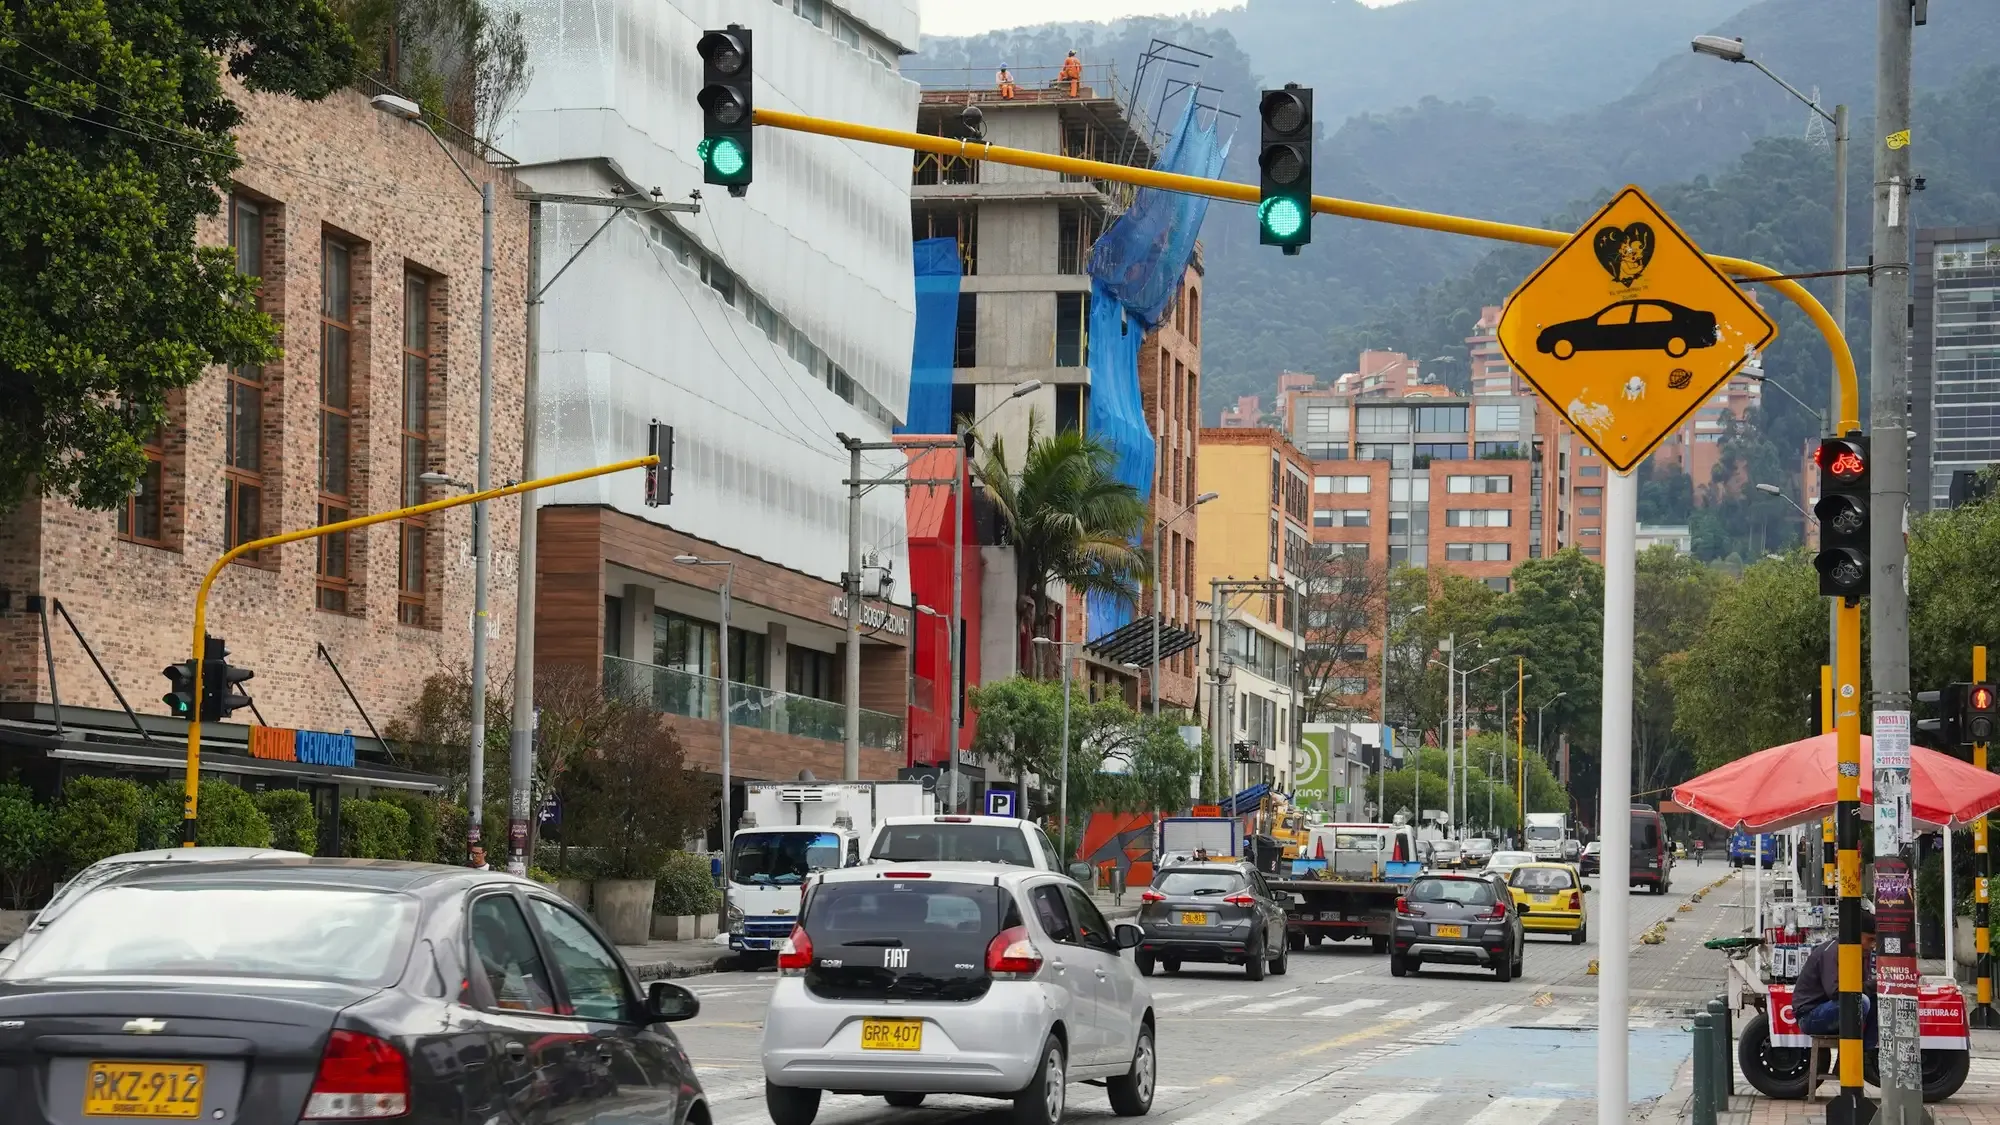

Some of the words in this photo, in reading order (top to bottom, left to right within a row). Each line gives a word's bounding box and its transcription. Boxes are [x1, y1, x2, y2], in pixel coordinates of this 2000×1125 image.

[1295, 788, 1322, 800] king
[992, 795, 1008, 813] P
[884, 948, 911, 968] FIAT
[1919, 1008, 1950, 1017] BERTURA
